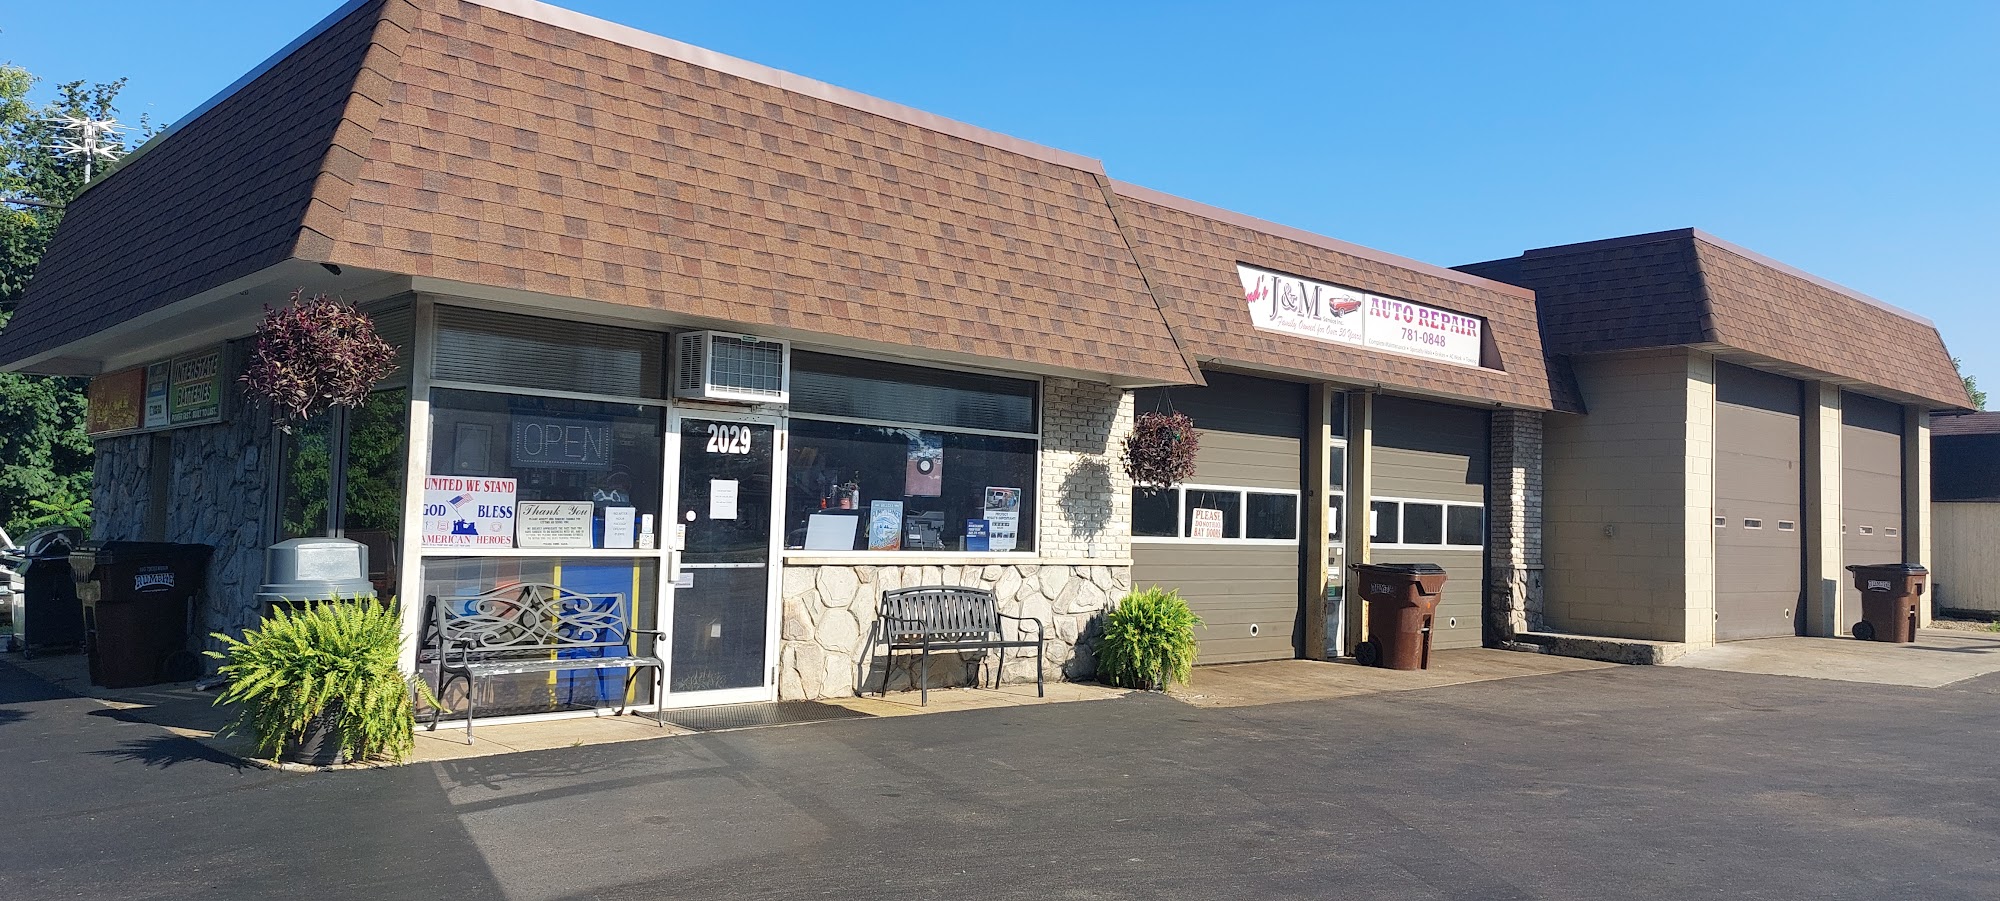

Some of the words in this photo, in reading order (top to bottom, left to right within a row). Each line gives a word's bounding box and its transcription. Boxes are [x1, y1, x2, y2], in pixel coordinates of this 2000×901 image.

[1269, 276, 1323, 321] J&M
[1277, 316, 1297, 330] Family
[1298, 320, 1316, 332] Owned
[1370, 297, 1414, 324] AUTO
[1418, 308, 1477, 337] REPAIR
[1401, 327, 1446, 347] 781-0848
[174, 353, 219, 385] INTERSTATE
[177, 381, 213, 408] BATTERIES
[524, 423, 602, 459] OPEN
[706, 423, 751, 455] 2029
[424, 477, 463, 491] UNITED
[466, 479, 480, 492] WE
[483, 480, 515, 493] STAND
[423, 503, 447, 516] GOD
[477, 504, 513, 519] BLESS
[522, 504, 561, 516] Thank
[567, 504, 588, 516] You
[1195, 510, 1221, 521] PLEASE
[422, 534, 471, 545] AMERICAN
[476, 535, 511, 545] HEROES
[1193, 527, 1205, 537] BAY
